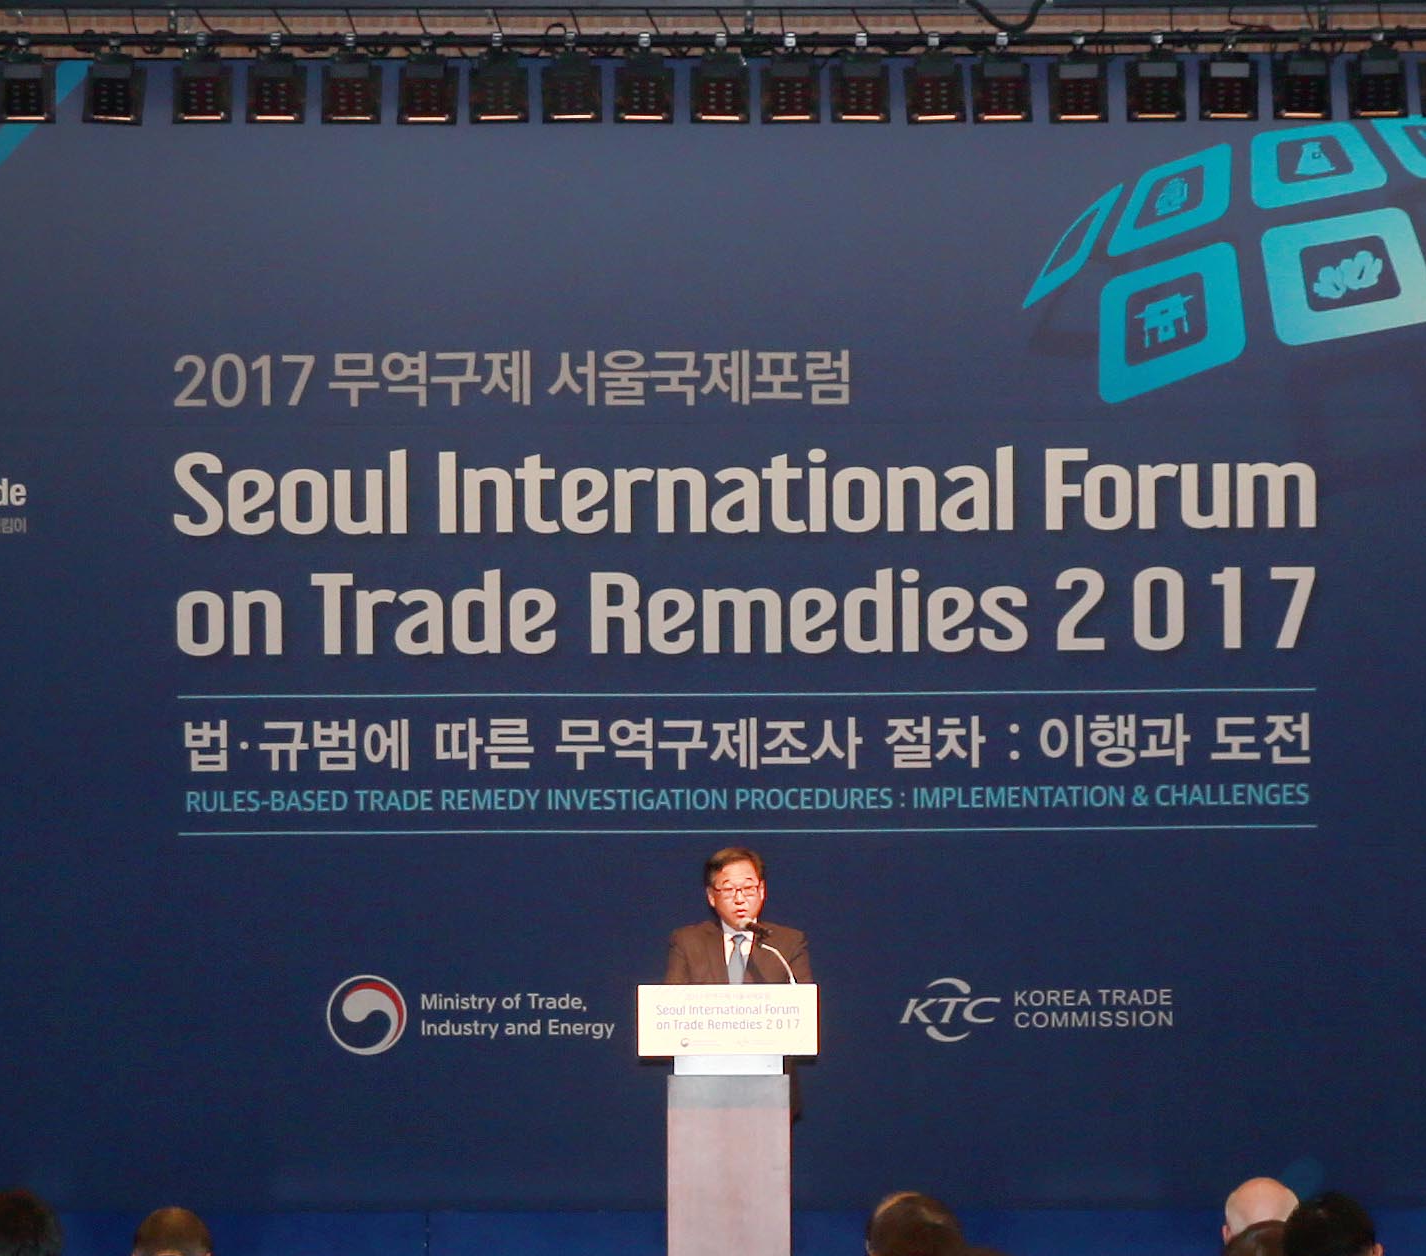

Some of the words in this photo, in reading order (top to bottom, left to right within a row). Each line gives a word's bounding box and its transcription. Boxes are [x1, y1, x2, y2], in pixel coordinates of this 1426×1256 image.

[173, 352, 316, 408] 2017
[328, 350, 532, 408] 무역구제
[548, 349, 850, 407] 서울국제포럼
[173, 449, 408, 537] Seoul
[438, 445, 1014, 536] International
[1045, 446, 1317, 531] Forum
[176, 588, 283, 657] on
[311, 568, 557, 656] Trade
[590, 567, 1029, 656] Remedies
[435, 717, 535, 771] 따른
[556, 715, 864, 770] 무역구제조사
[885, 715, 987, 769] 절차
[1039, 712, 1191, 768] 이행과
[1210, 711, 1311, 766] 도전
[185, 789, 349, 813] RULES-BASED
[354, 789, 434, 812] TRADE
[440, 788, 540, 812] REMEDY
[547, 787, 729, 811] INVESTIGATION
[734, 786, 894, 811] PROCEDURES
[913, 785, 1126, 810] IMPLEMENTATION
[1131, 784, 1151, 808] &
[1155, 782, 1310, 807] CHALLENGES
[421, 992, 497, 1013] Ministry
[502, 992, 522, 1010] of
[527, 993, 588, 1012] Trade,
[656, 1004, 686, 1016] Seoul
[689, 1004, 762, 1016] International
[765, 1004, 800, 1015] Forum
[900, 996, 1001, 1024] KTC
[1014, 989, 1092, 1007] KOREA
[1098, 989, 1173, 1006] TRADE
[421, 1018, 499, 1040] Industry
[504, 1018, 541, 1036] and
[547, 1018, 616, 1040] Energy
[674, 1019, 704, 1030] Trade
[707, 1019, 763, 1030] Remedies
[1014, 1010, 1174, 1028] COMMISSION
